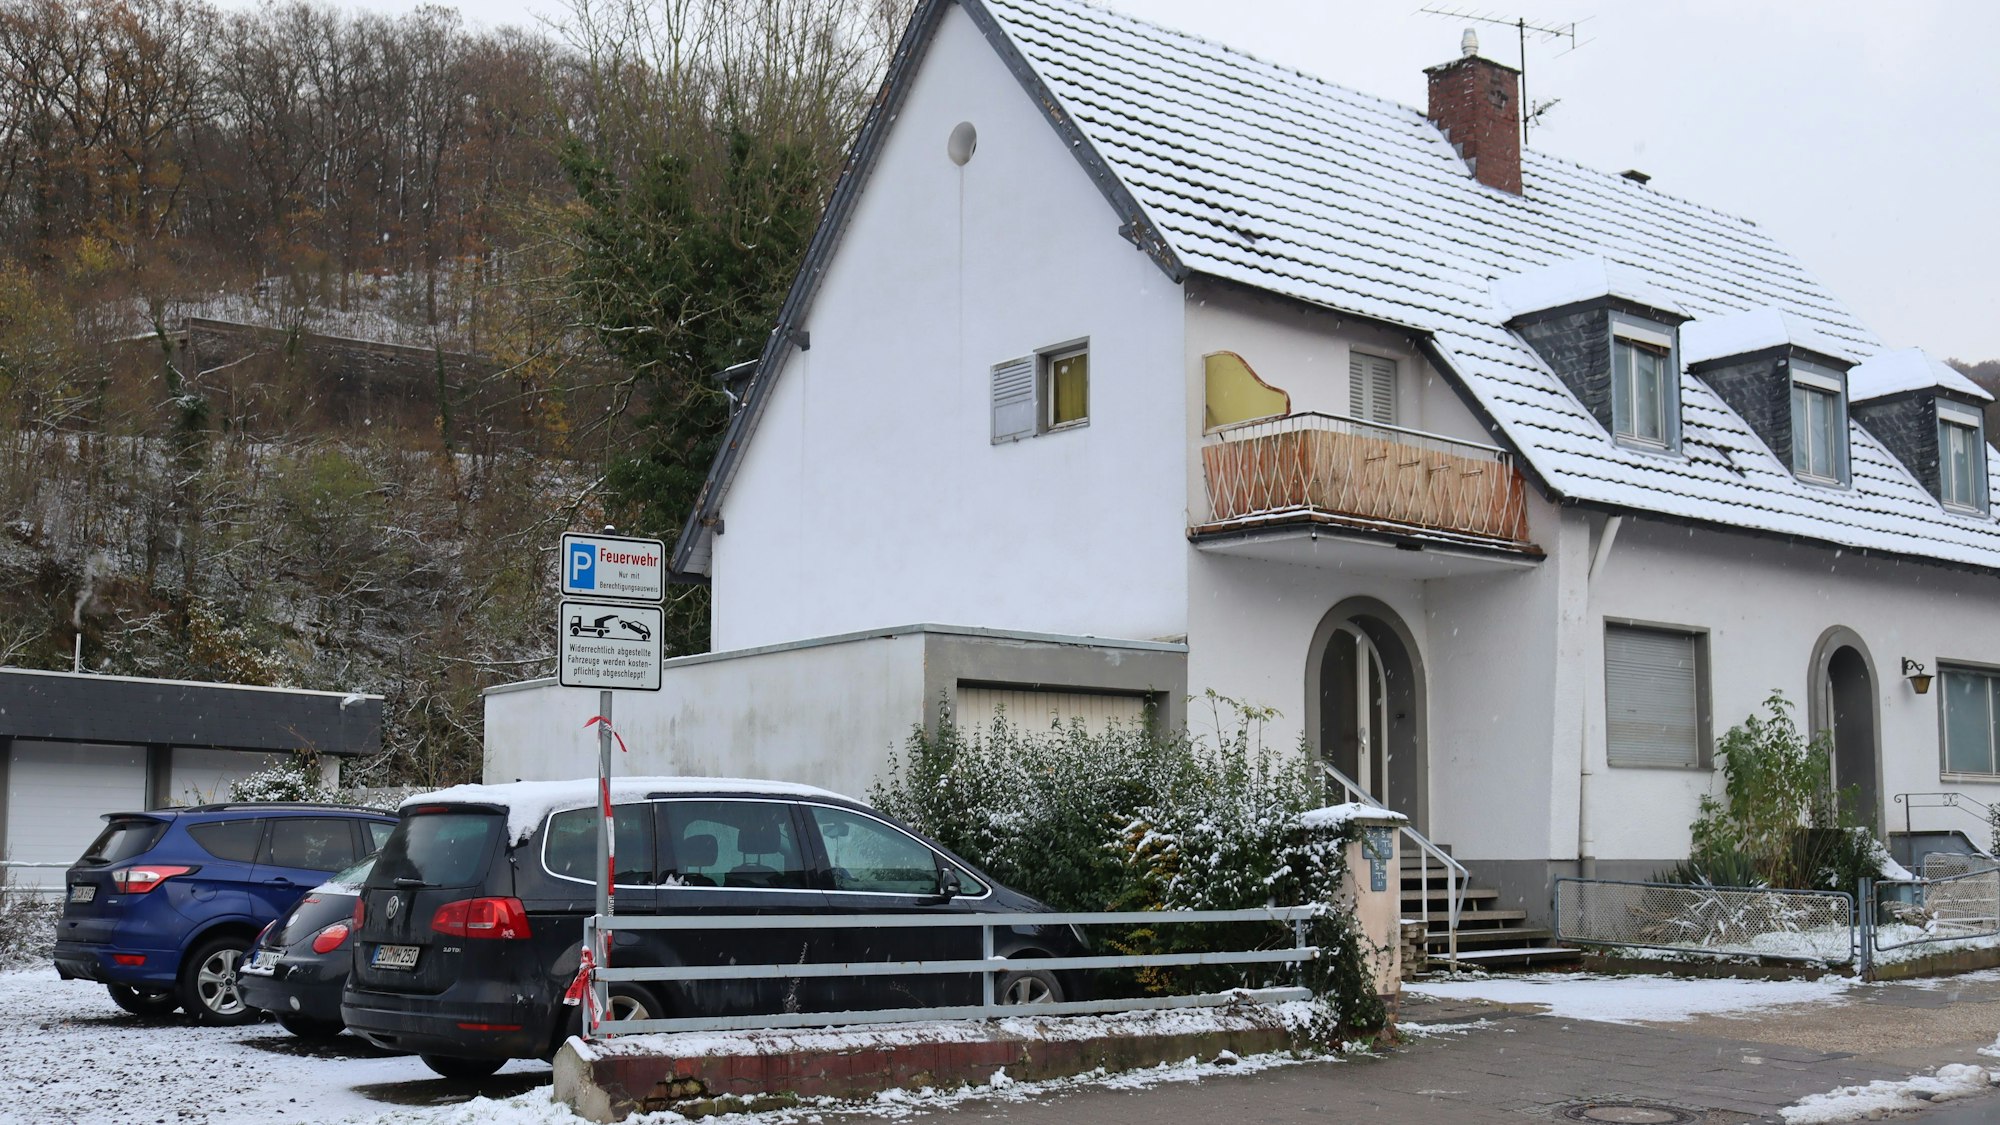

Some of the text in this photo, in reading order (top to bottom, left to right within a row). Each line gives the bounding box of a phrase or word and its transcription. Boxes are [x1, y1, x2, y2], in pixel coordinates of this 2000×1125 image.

[600, 548, 658, 567] Feuerwehr
[573, 551, 592, 580] P
[599, 581, 658, 593] Berechtigungsausweis
[569, 643, 652, 657] Widerrechtlich abgestellte
[567, 655, 652, 668] Fahrzeuge werden kosten-
[573, 667, 646, 680] pflichtig abgeschleppt!
